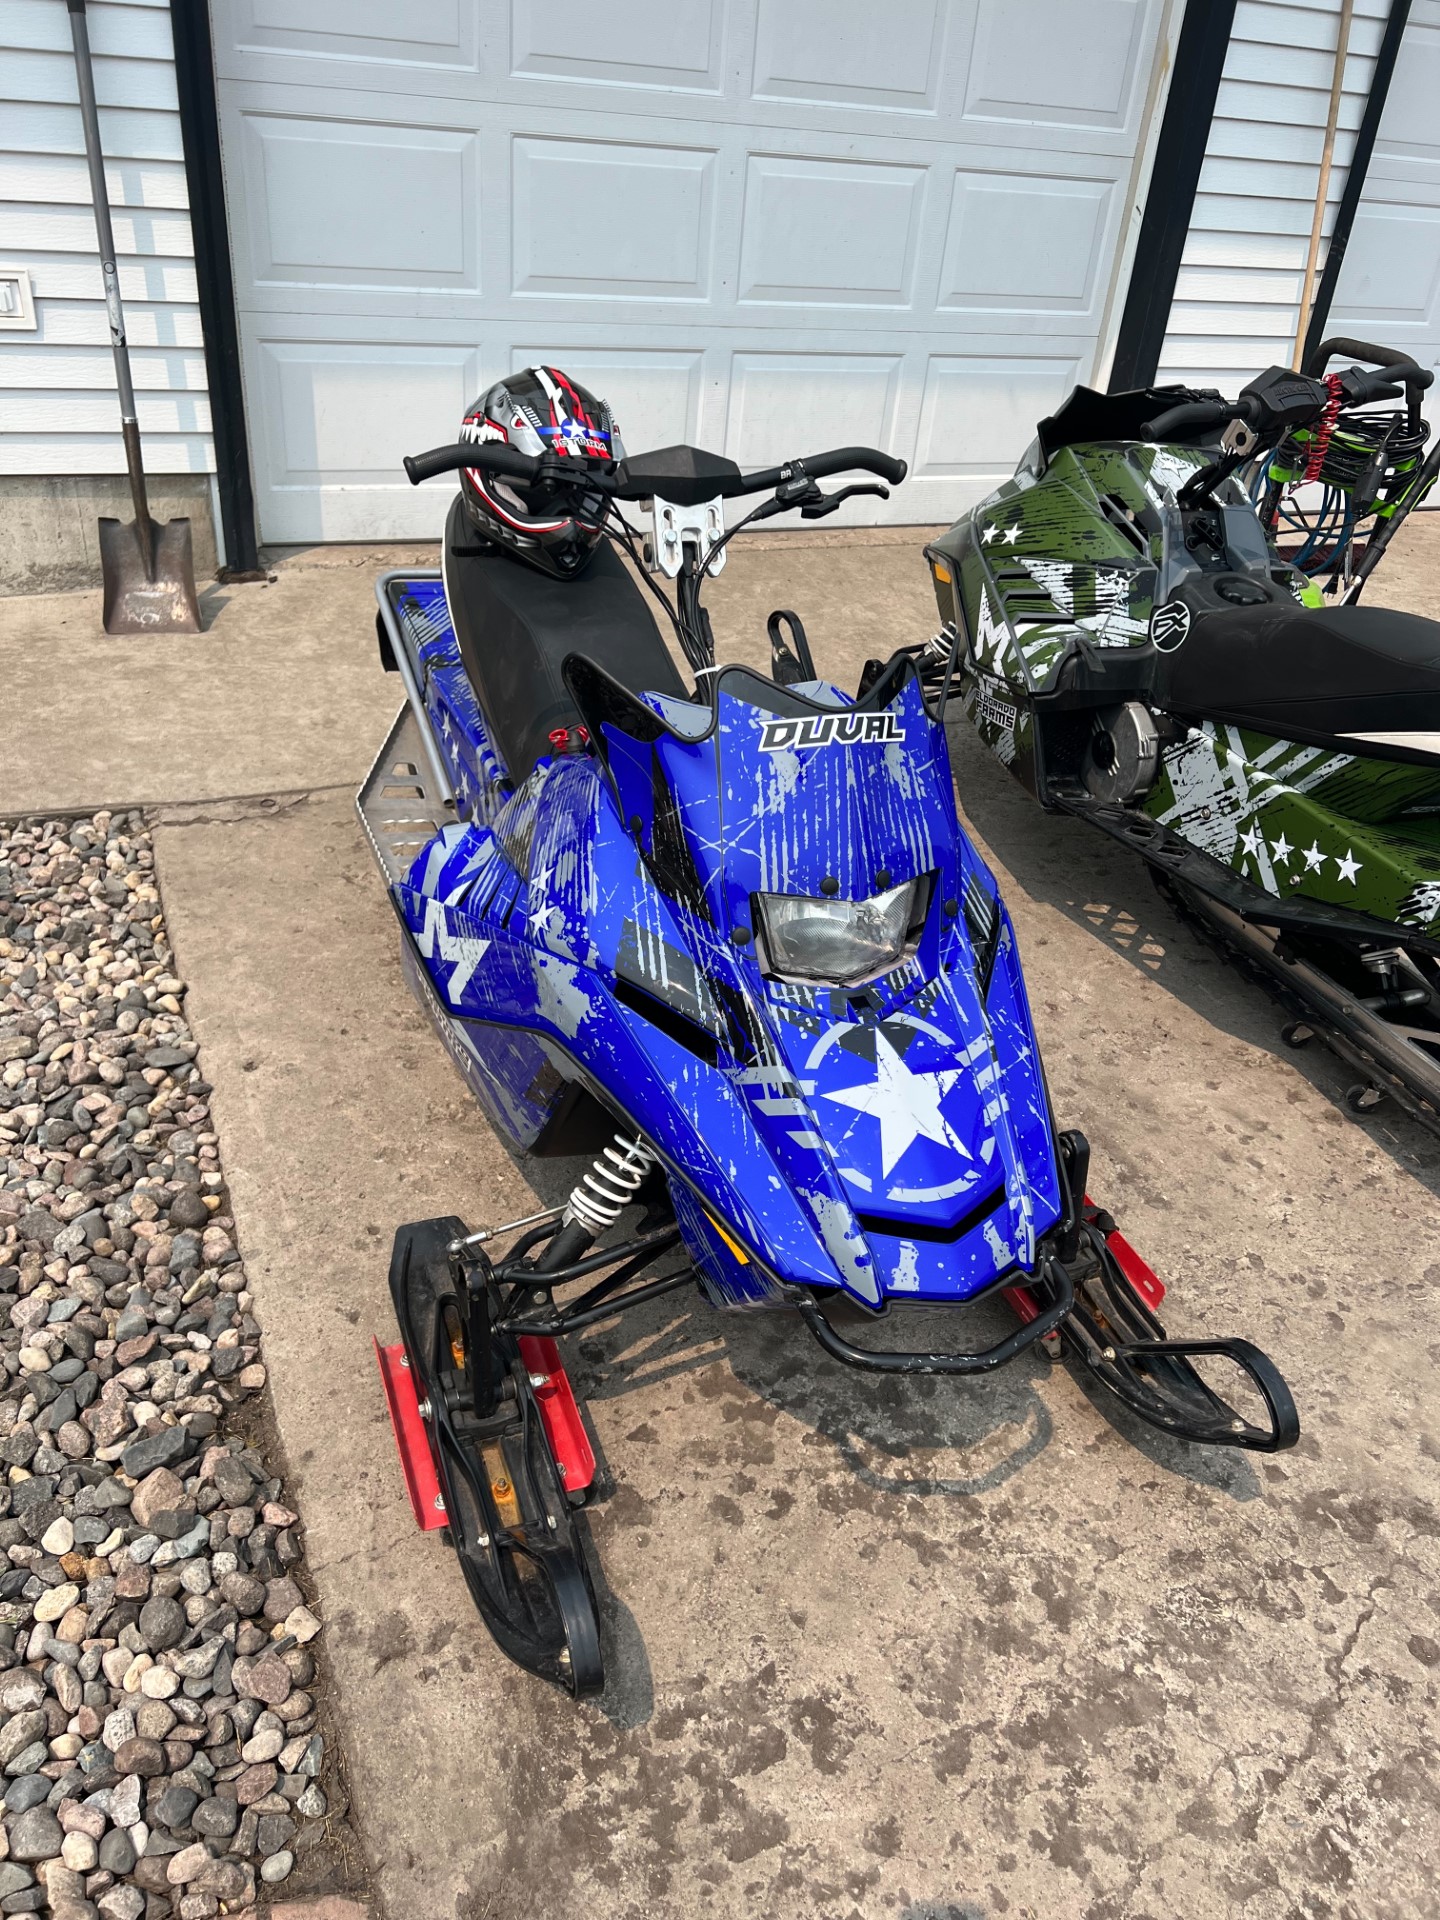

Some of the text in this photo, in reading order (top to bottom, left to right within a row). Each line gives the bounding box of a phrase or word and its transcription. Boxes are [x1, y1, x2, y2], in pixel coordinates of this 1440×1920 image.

[974, 689, 1017, 717] ELDORADO
[975, 698, 1015, 730] FARMS
[757, 712, 906, 752] DUVAL
